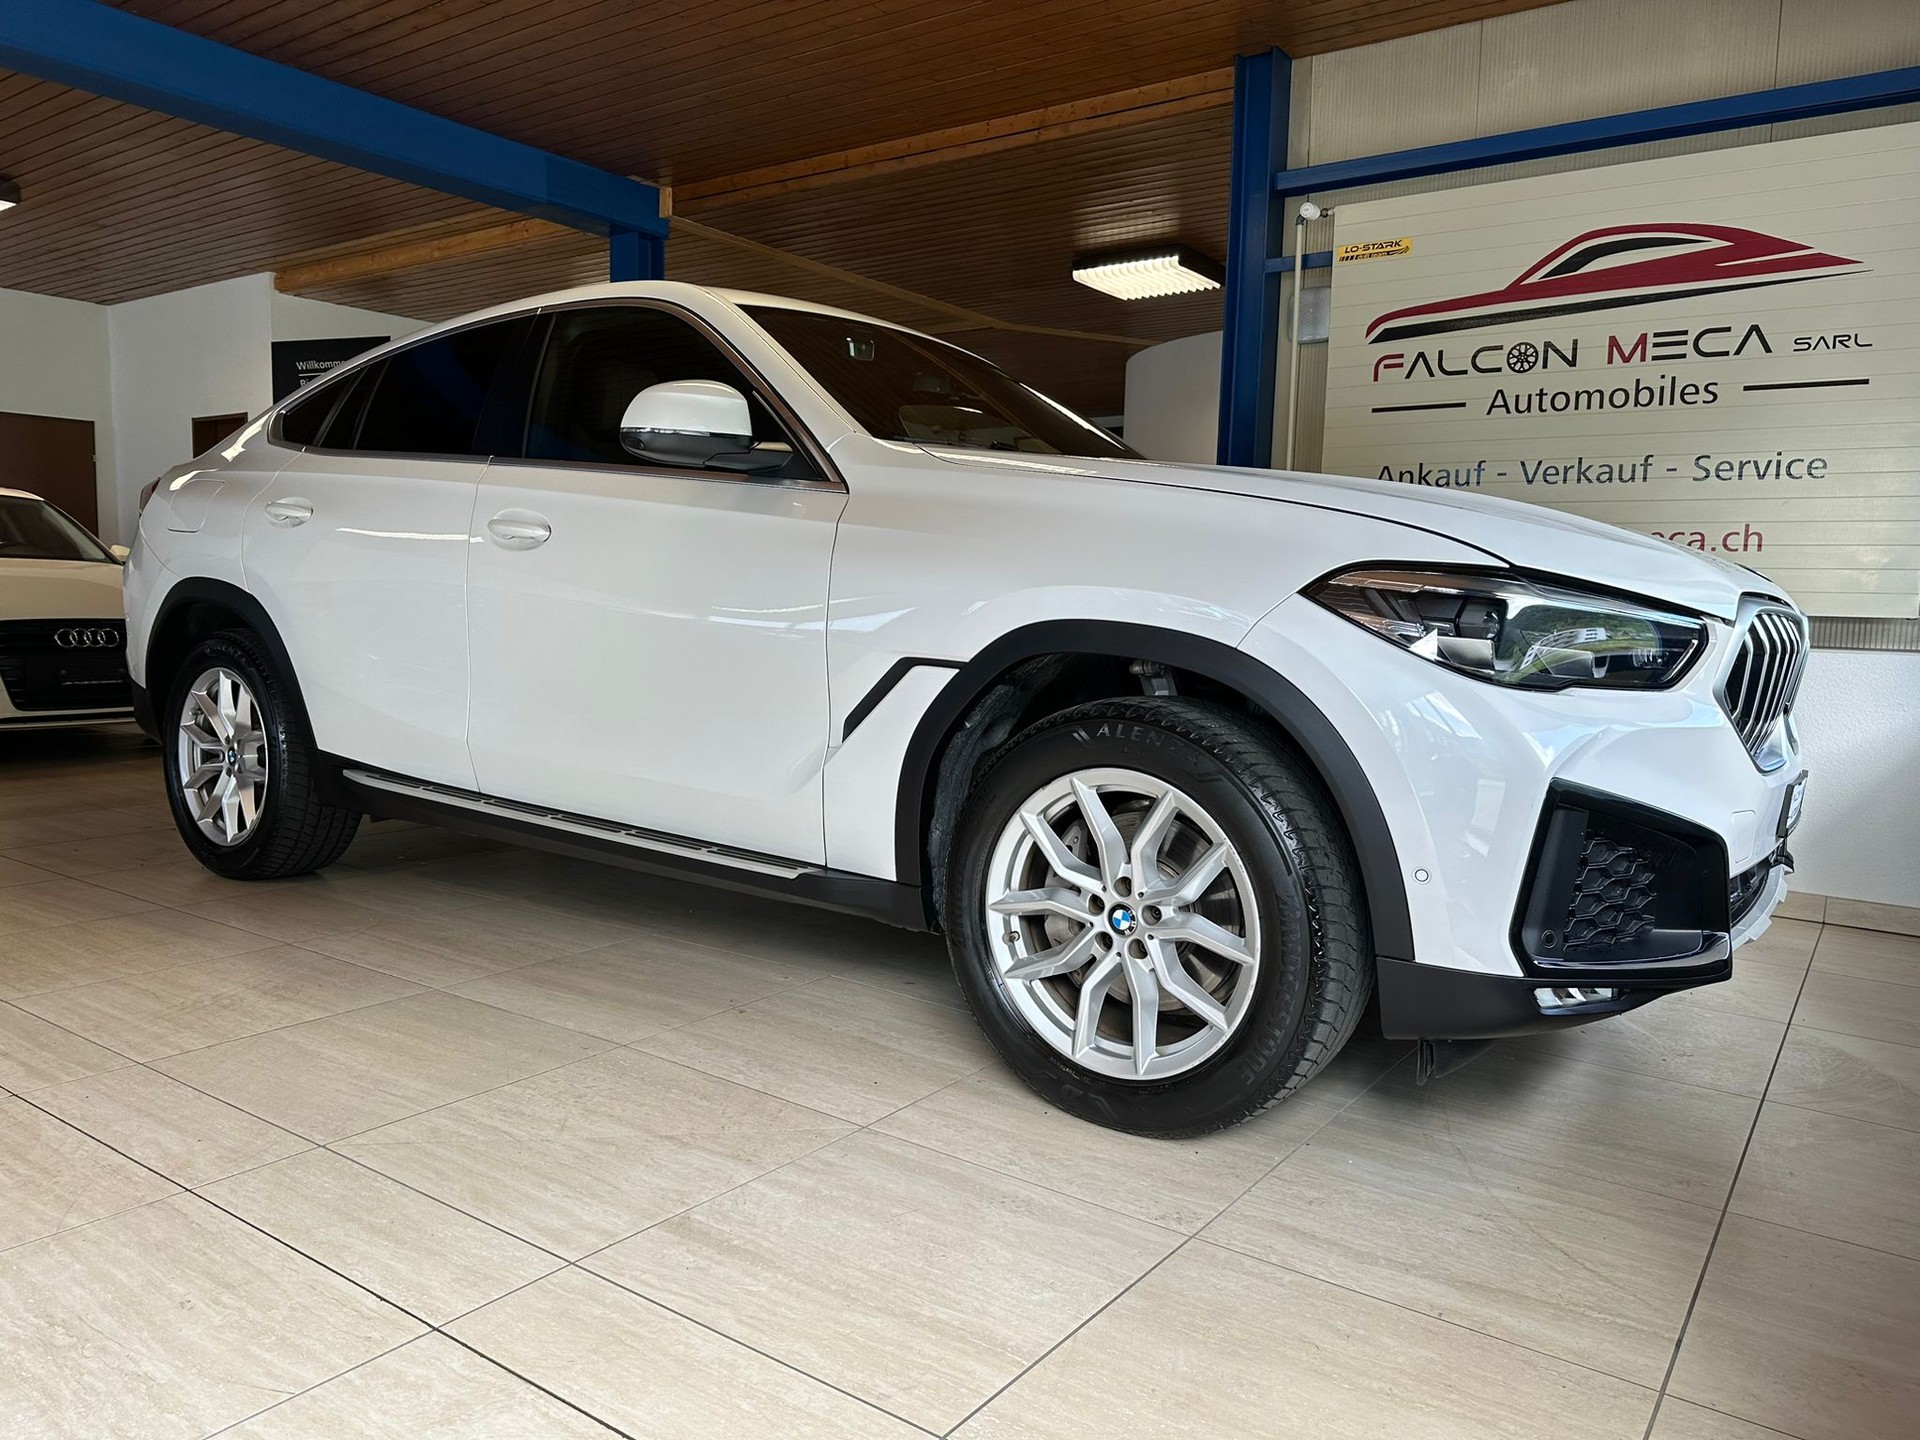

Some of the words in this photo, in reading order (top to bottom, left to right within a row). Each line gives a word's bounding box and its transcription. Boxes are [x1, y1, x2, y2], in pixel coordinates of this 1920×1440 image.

[1344, 239, 1402, 254] LO-STARK
[1373, 338, 1578, 382] FALCON
[1607, 324, 1773, 364] MECA
[1793, 333, 1873, 352] SARL
[1486, 374, 1719, 415] Automobiles
[1378, 460, 1486, 487] Ankauf
[1520, 455, 1653, 485] Verkauf
[1692, 452, 1828, 481] Service
